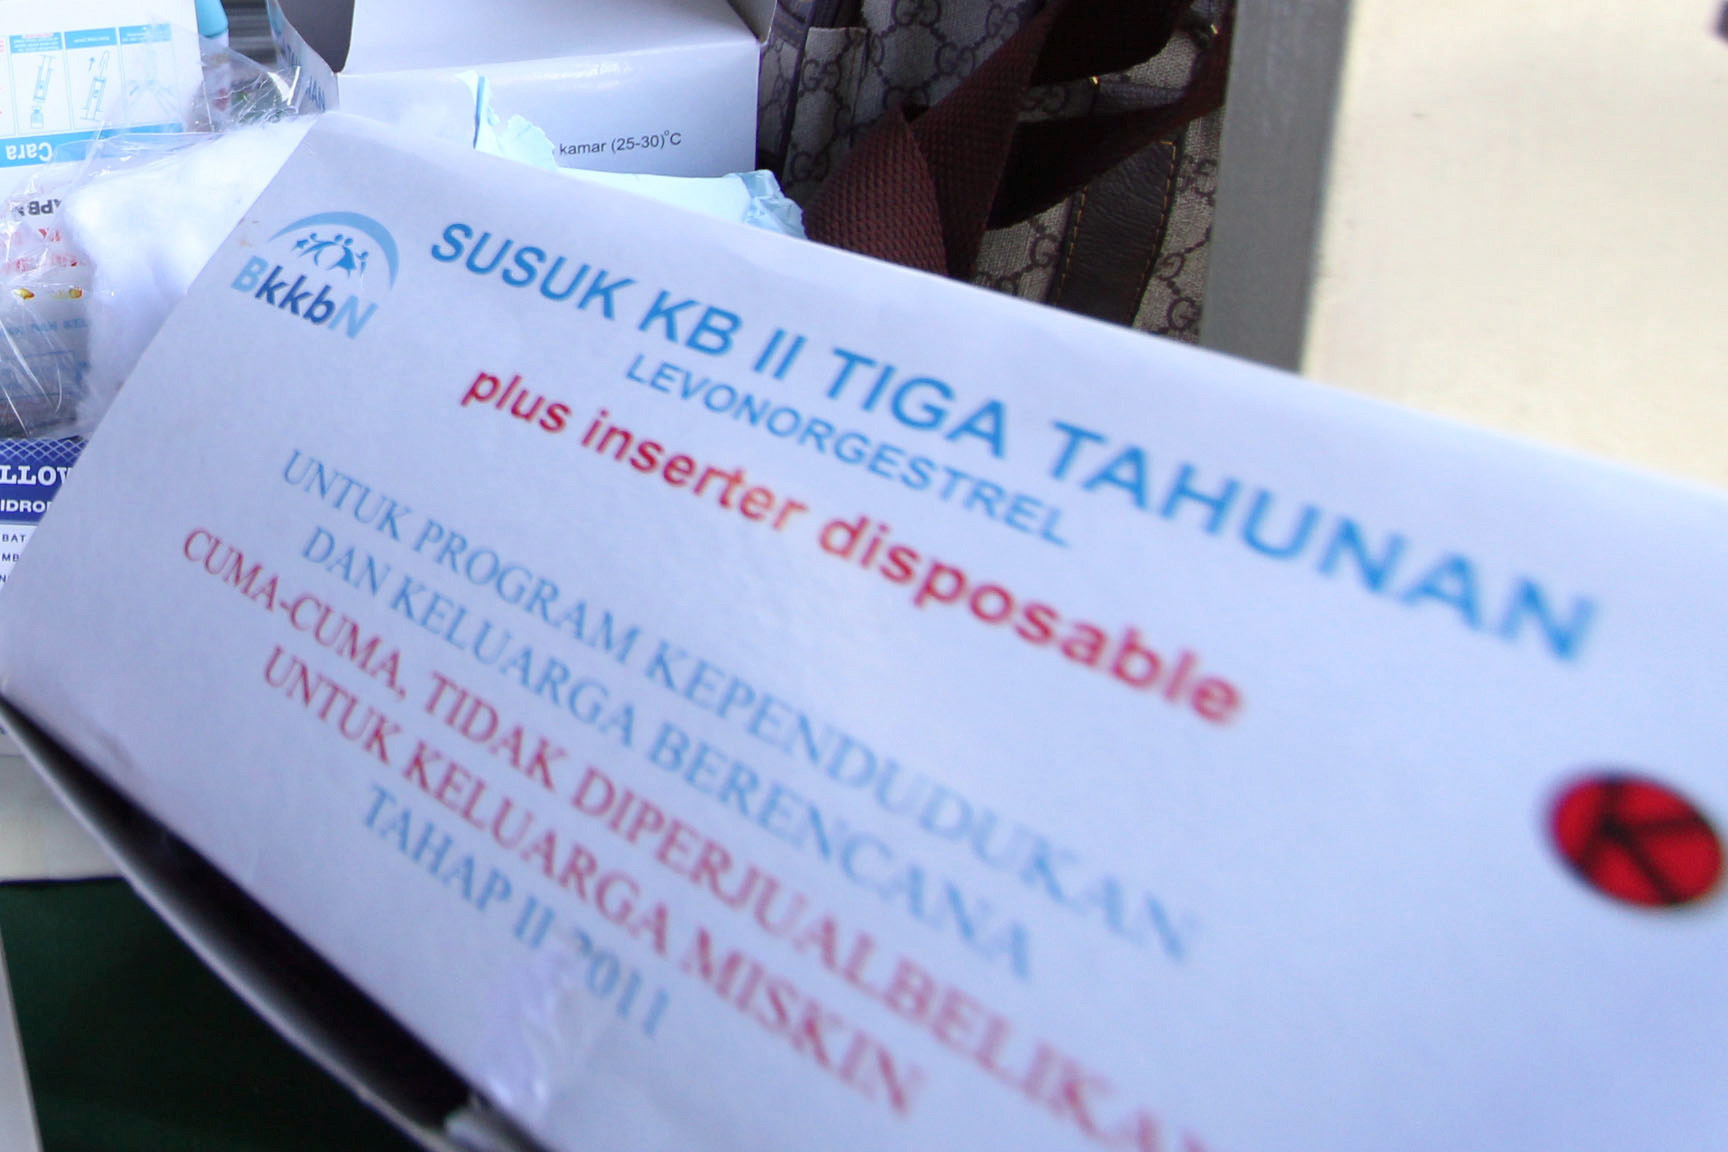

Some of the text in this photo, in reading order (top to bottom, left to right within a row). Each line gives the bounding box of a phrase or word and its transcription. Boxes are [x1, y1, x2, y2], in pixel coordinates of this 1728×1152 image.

[6, 142, 52, 161] Cara
[231, 255, 378, 339] BkkbN
[559, 140, 606, 156] kamar
[431, 222, 1601, 663] SUSUK KB II TIGA TAHUNAN
[462, 368, 1245, 726] plus inserter disposable
[626, 353, 1073, 550] LEVONORGESTREL
[182, 527, 1210, 1152] CUMA-CUMA, TIDAK DIPERJUALBELIKA
[261, 647, 927, 1122] UNTUK KELUARGA MISKIN
[281, 449, 1201, 962] UNTUK PROGRAM KEPENDUDUKAN
[301, 524, 1035, 981] DAN KELUARGA BERENCANA
[361, 783, 511, 911] TAHAP
[510, 892, 558, 953] II
